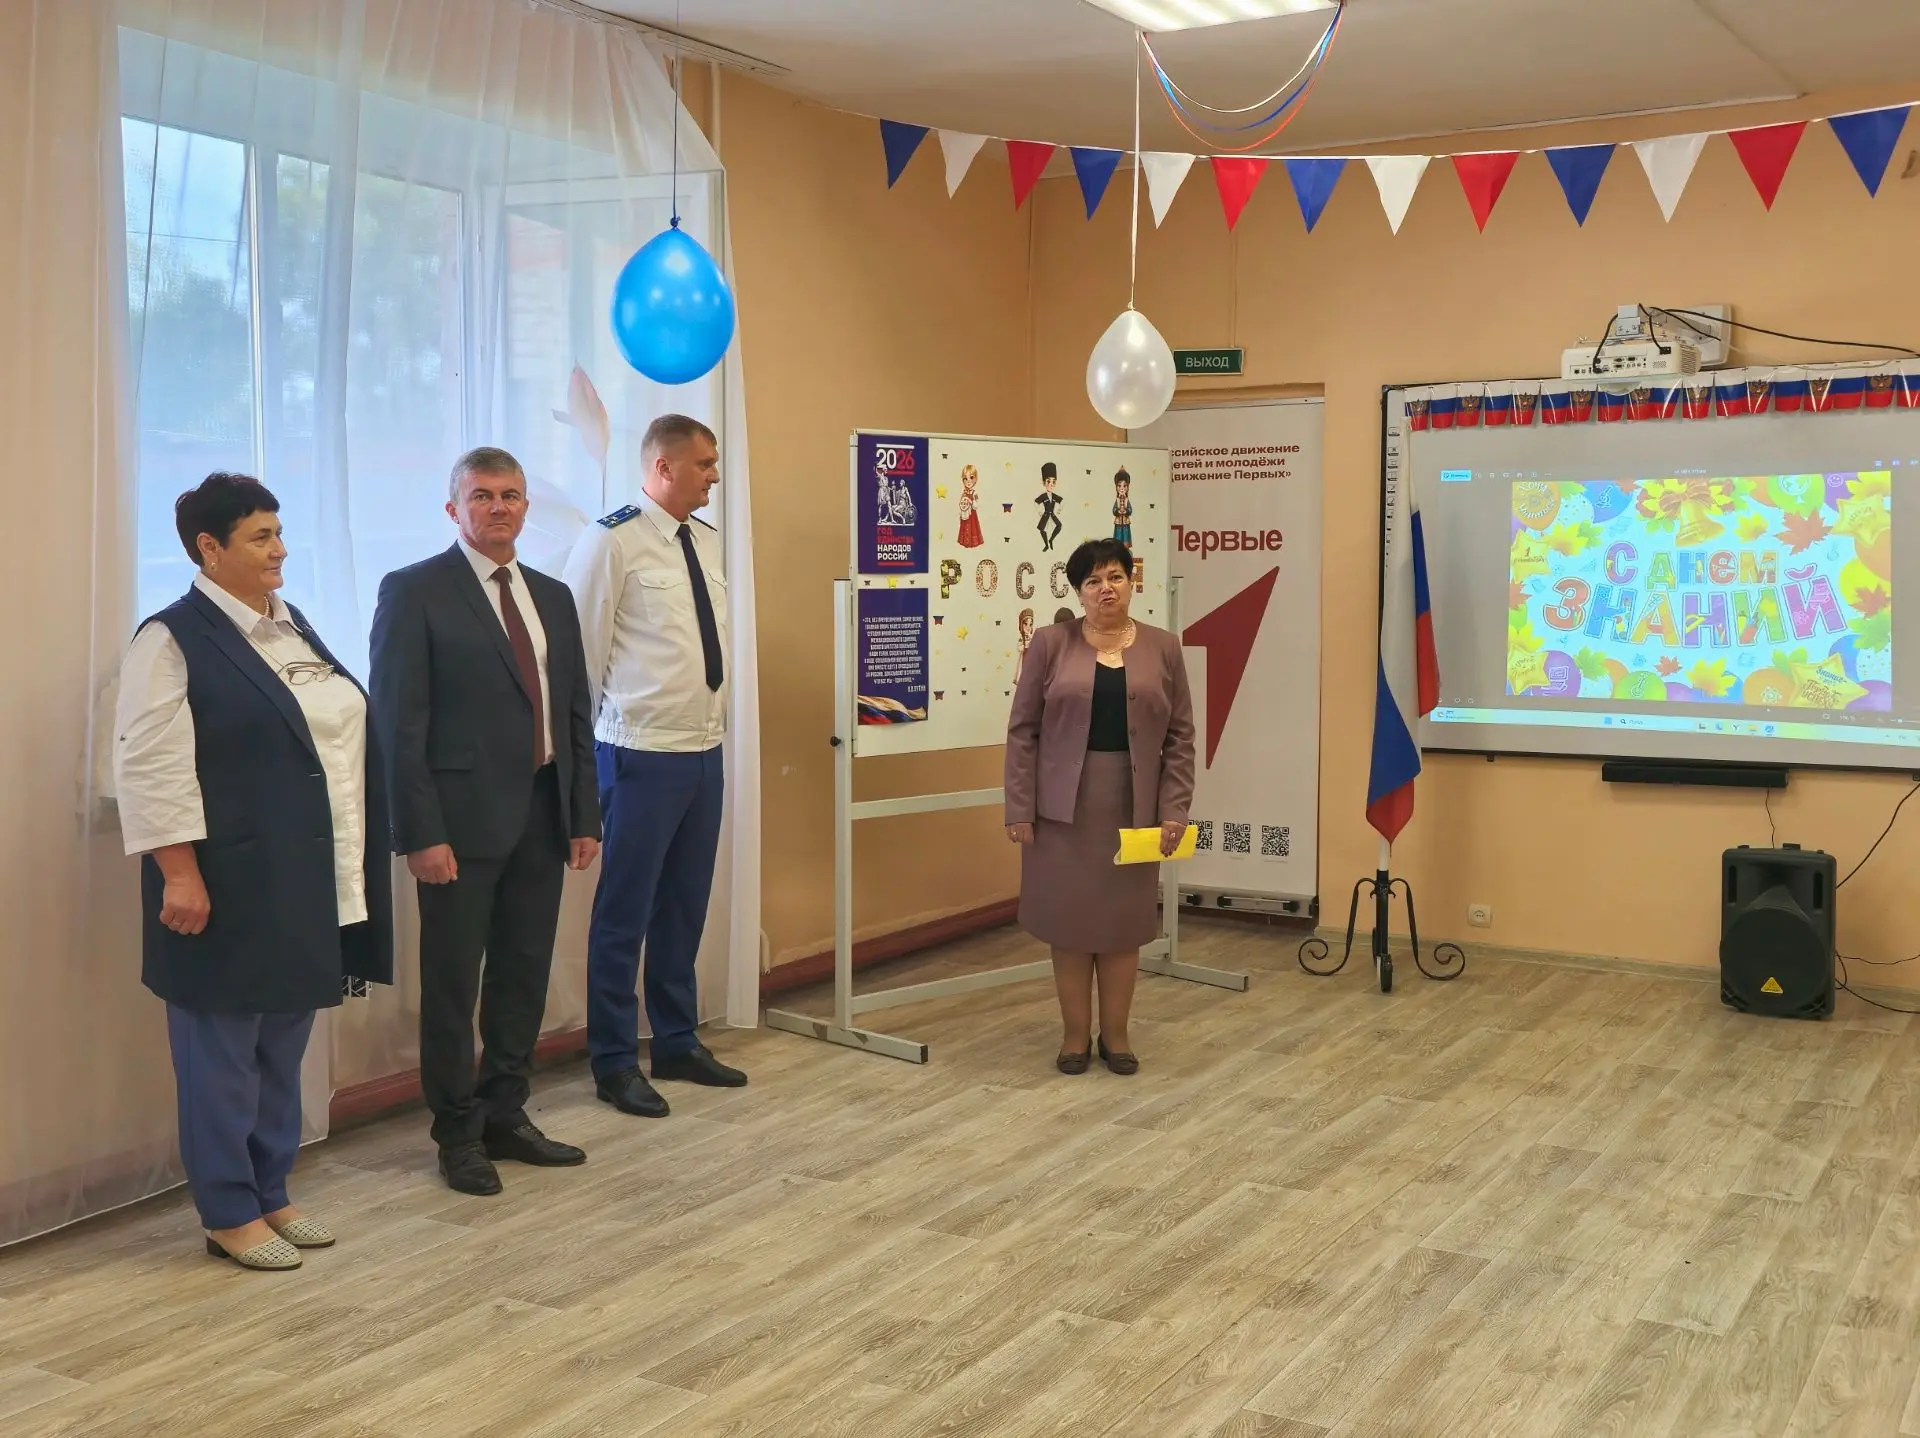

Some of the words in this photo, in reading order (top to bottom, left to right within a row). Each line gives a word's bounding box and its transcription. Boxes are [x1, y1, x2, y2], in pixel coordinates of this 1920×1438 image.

[1185, 356, 1230, 369] ВЫХОД
[1231, 444, 1300, 456] движение
[876, 448, 915, 470] 2026
[1216, 456, 1286, 468] молодёжи
[1234, 469, 1291, 481] Первых»
[877, 527, 893, 537] ГОД
[877, 544, 912, 553] НАРОДОВ
[877, 552, 908, 561] РОССИИ
[1605, 541, 1638, 585] С
[940, 557, 1144, 600] РОССЯ
[1543, 563, 1847, 648] ЗНАНИЙ
